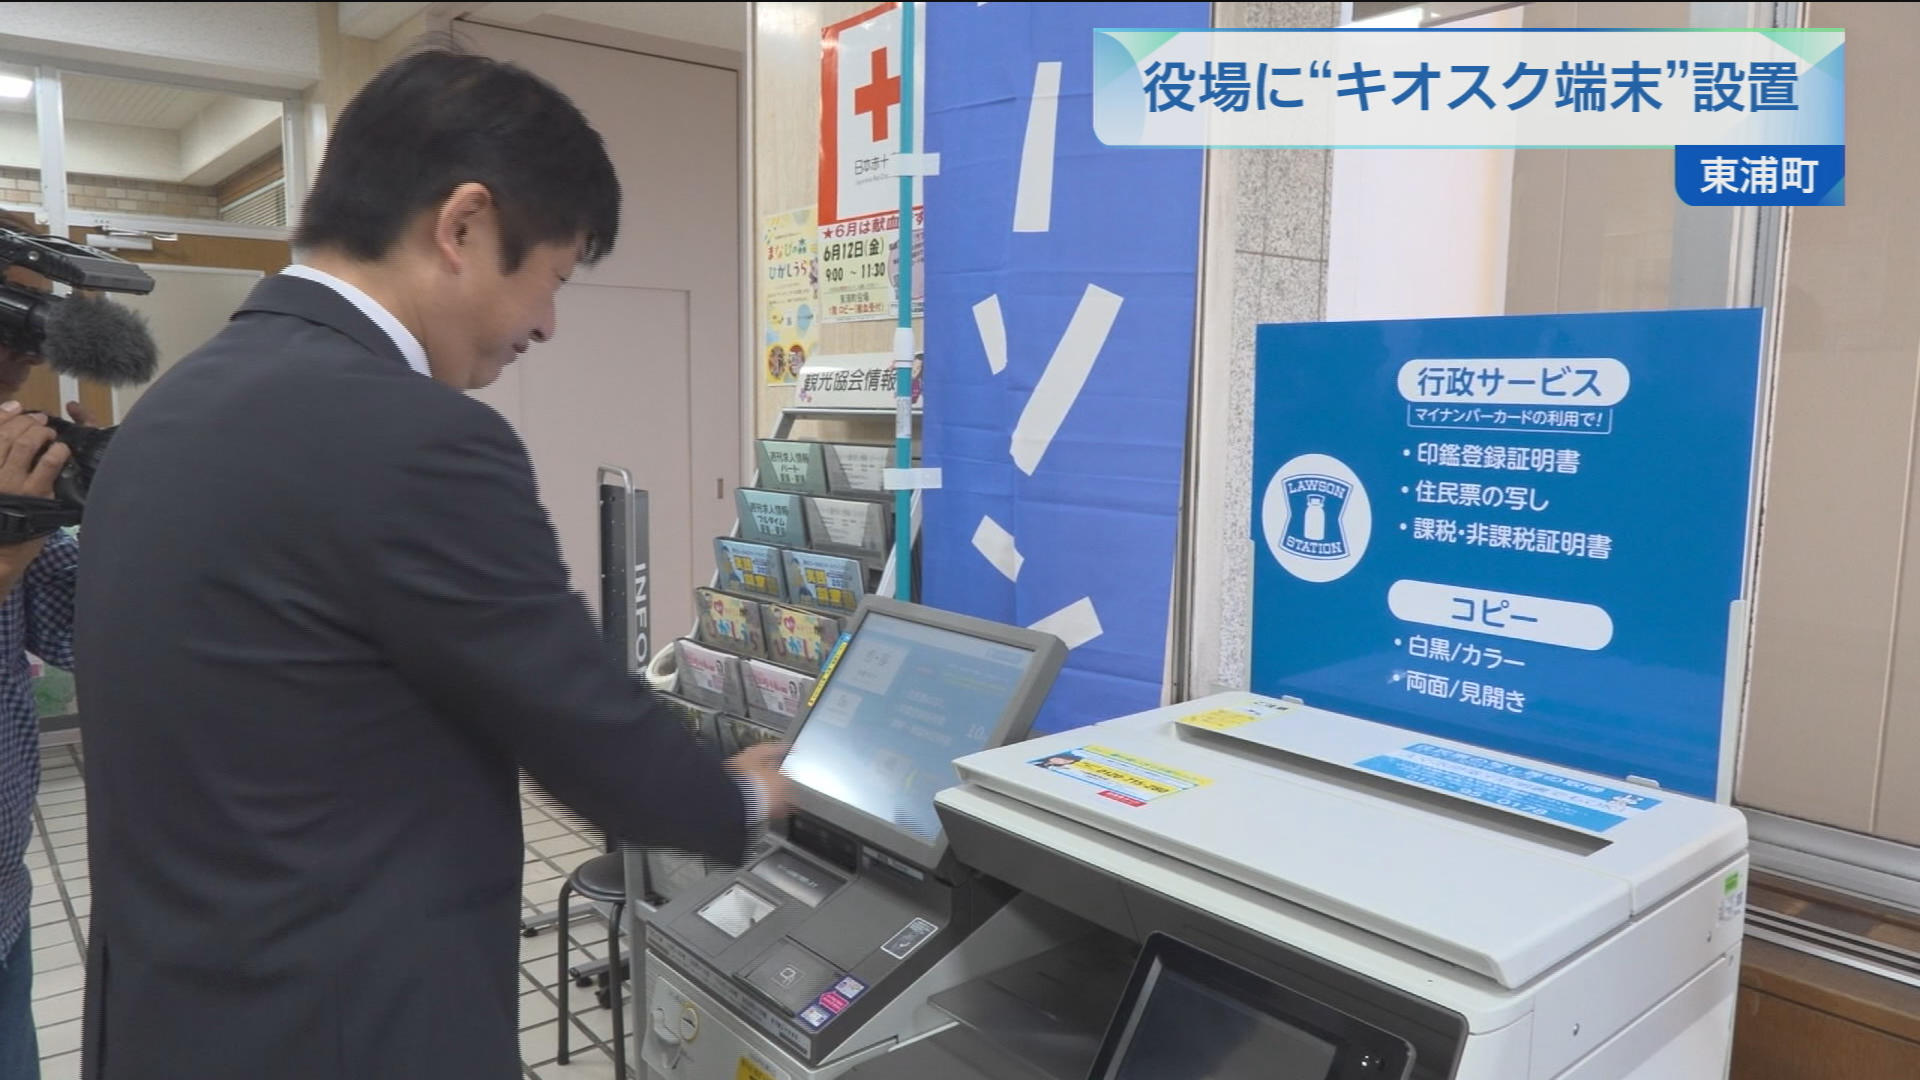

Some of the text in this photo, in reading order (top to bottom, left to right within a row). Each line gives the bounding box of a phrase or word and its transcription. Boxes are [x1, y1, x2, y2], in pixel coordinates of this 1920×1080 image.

[826, 267, 843, 282] 9:00
[862, 262, 886, 279] 11:30
[972, 3, 1124, 650] ーソン
[803, 369, 897, 392] 観光協会情報
[1417, 366, 1602, 398] 行政サービス
[1416, 442, 1581, 474] 印鑑登録証明書
[1287, 479, 1347, 499] LAWSON
[1414, 480, 1550, 512] 住民票の写し
[1285, 535, 1343, 555] STATION
[1451, 596, 1538, 629] コピー
[1407, 634, 1526, 668] 白黒/カラー
[1405, 670, 1526, 713] 両面/見開き
